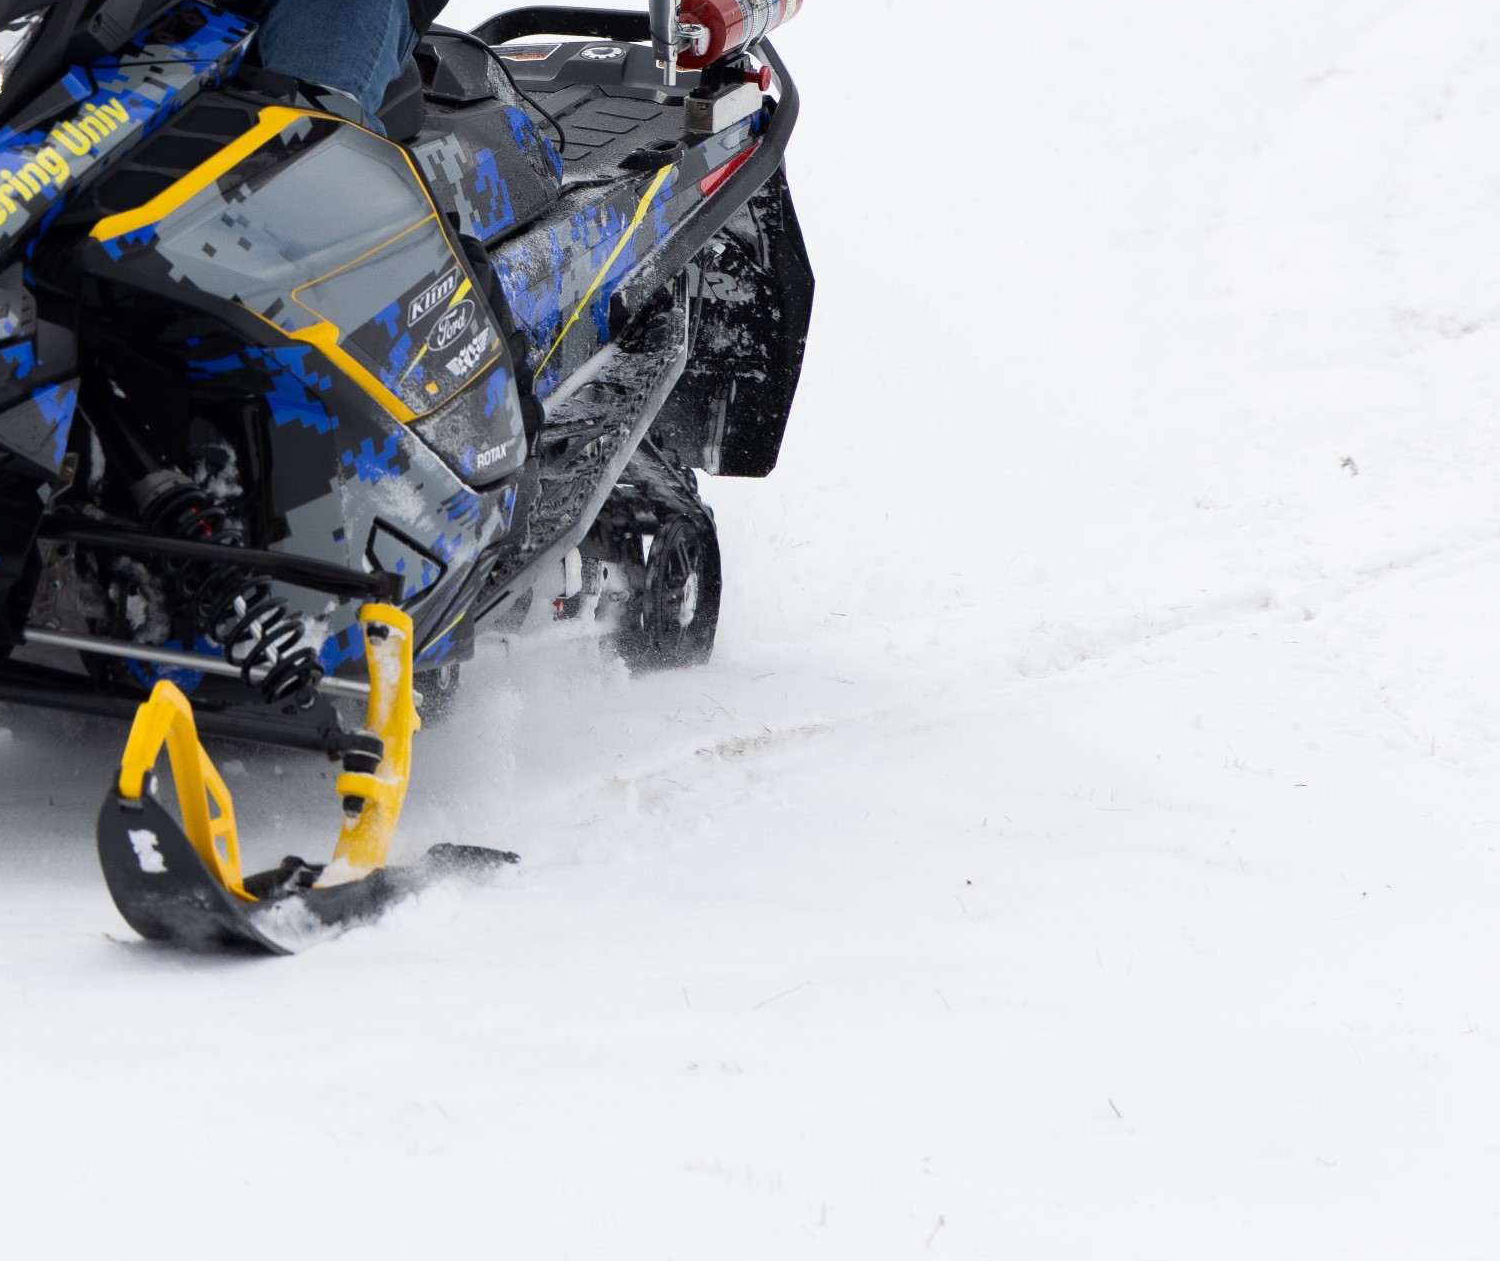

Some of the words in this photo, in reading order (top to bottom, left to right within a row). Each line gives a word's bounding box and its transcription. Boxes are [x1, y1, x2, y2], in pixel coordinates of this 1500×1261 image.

[51, 96, 130, 157] Univ
[437, 307, 466, 347] Ford
[477, 442, 507, 468] ROTAX
